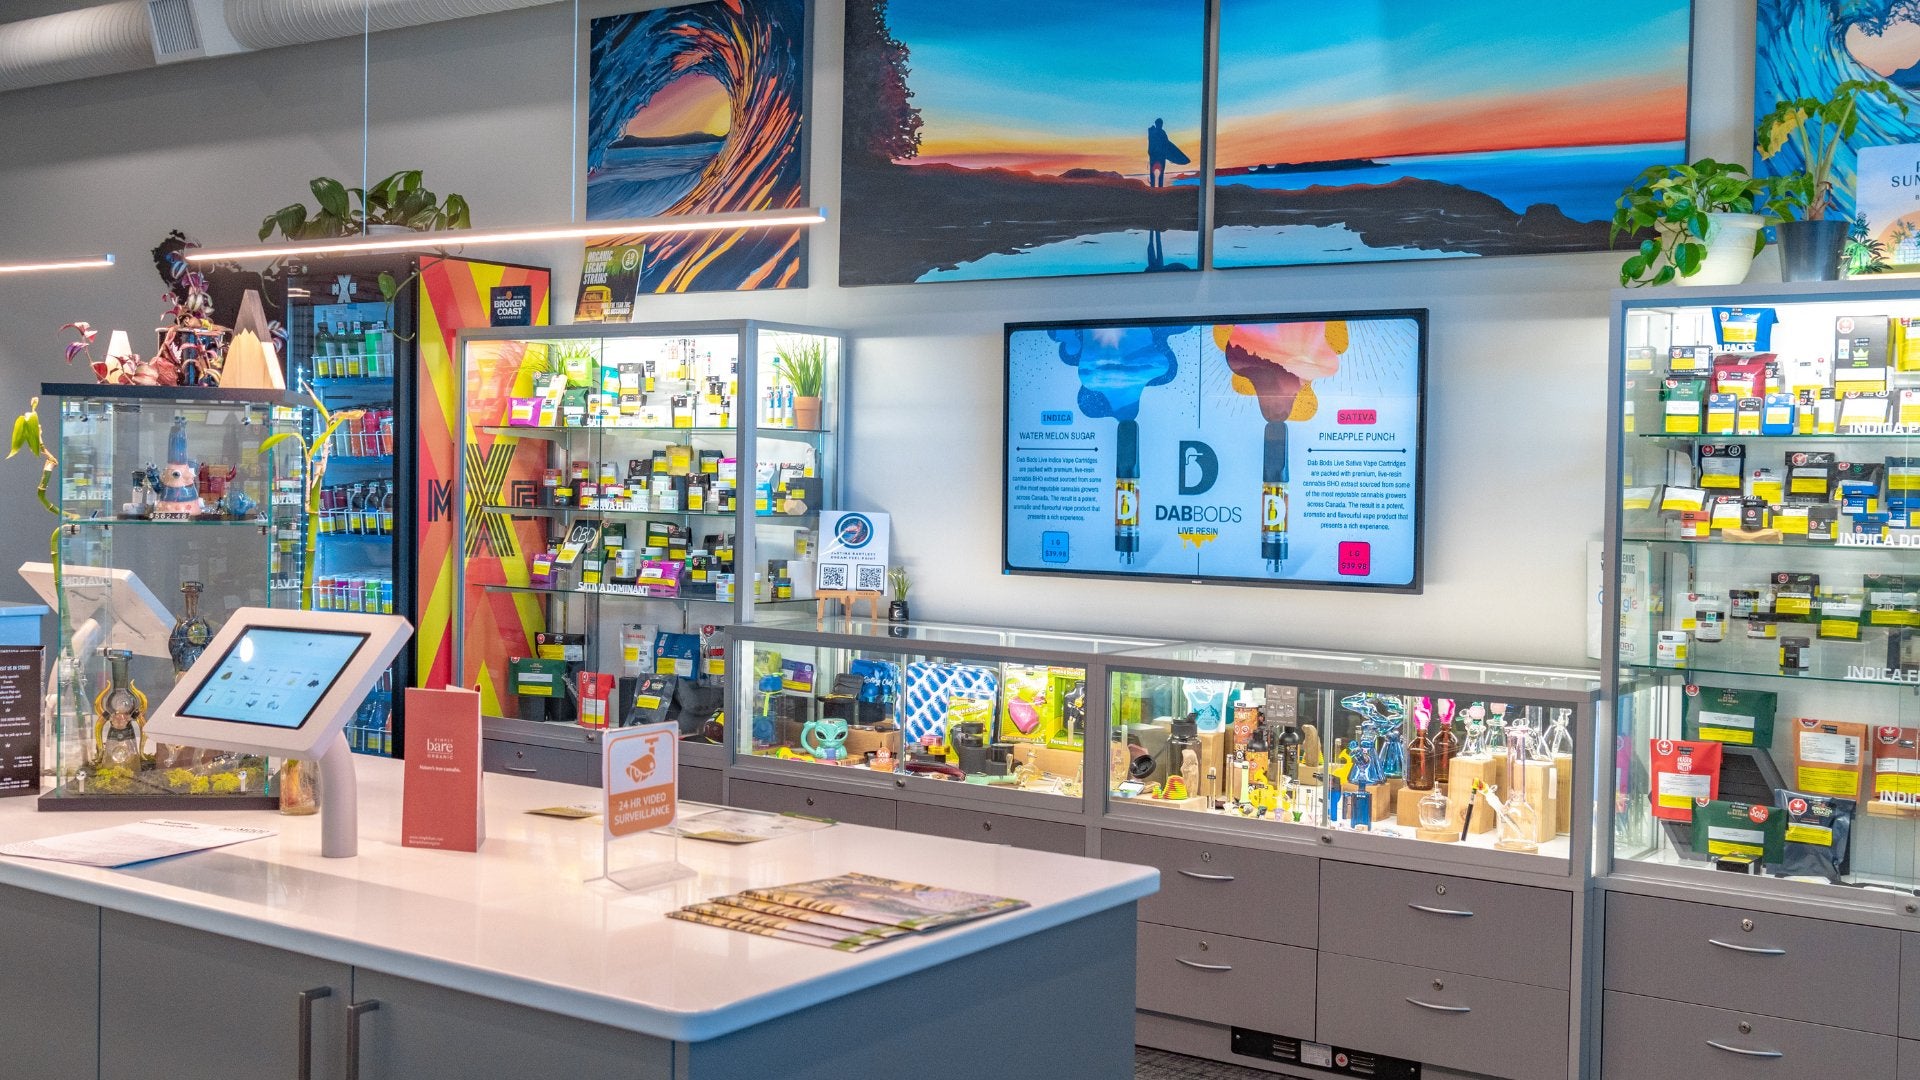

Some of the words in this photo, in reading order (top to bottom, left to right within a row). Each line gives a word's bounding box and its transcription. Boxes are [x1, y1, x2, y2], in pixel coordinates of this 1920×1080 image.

[588, 250, 614, 262] ORGANIC
[584, 262, 608, 273] LEGACY
[583, 273, 608, 284] STRAINS
[494, 300, 526, 308] BROKEN
[497, 308, 522, 316] COAST
[1850, 423, 1904, 434] INDICA
[1020, 432, 1044, 440] WATER
[1045, 432, 1070, 440] MELON
[1070, 432, 1096, 440] SUGAR
[1319, 432, 1364, 440] PINEAPPLE
[1366, 432, 1396, 440] PUNCH
[1156, 505, 1242, 522] DABBODS
[572, 526, 596, 542] CBD
[1196, 527, 1218, 535] RESIN
[1840, 532, 1894, 545] INDICA
[606, 584, 650, 596] DOMINANT
[1847, 666, 1902, 681] INDICA
[427, 738, 454, 752] bare
[618, 801, 628, 811] 24
[630, 798, 642, 808] HR
[644, 792, 666, 804] VIDEO
[614, 804, 670, 826] SURVEILLANCE
[1750, 807, 1766, 820] Sale
